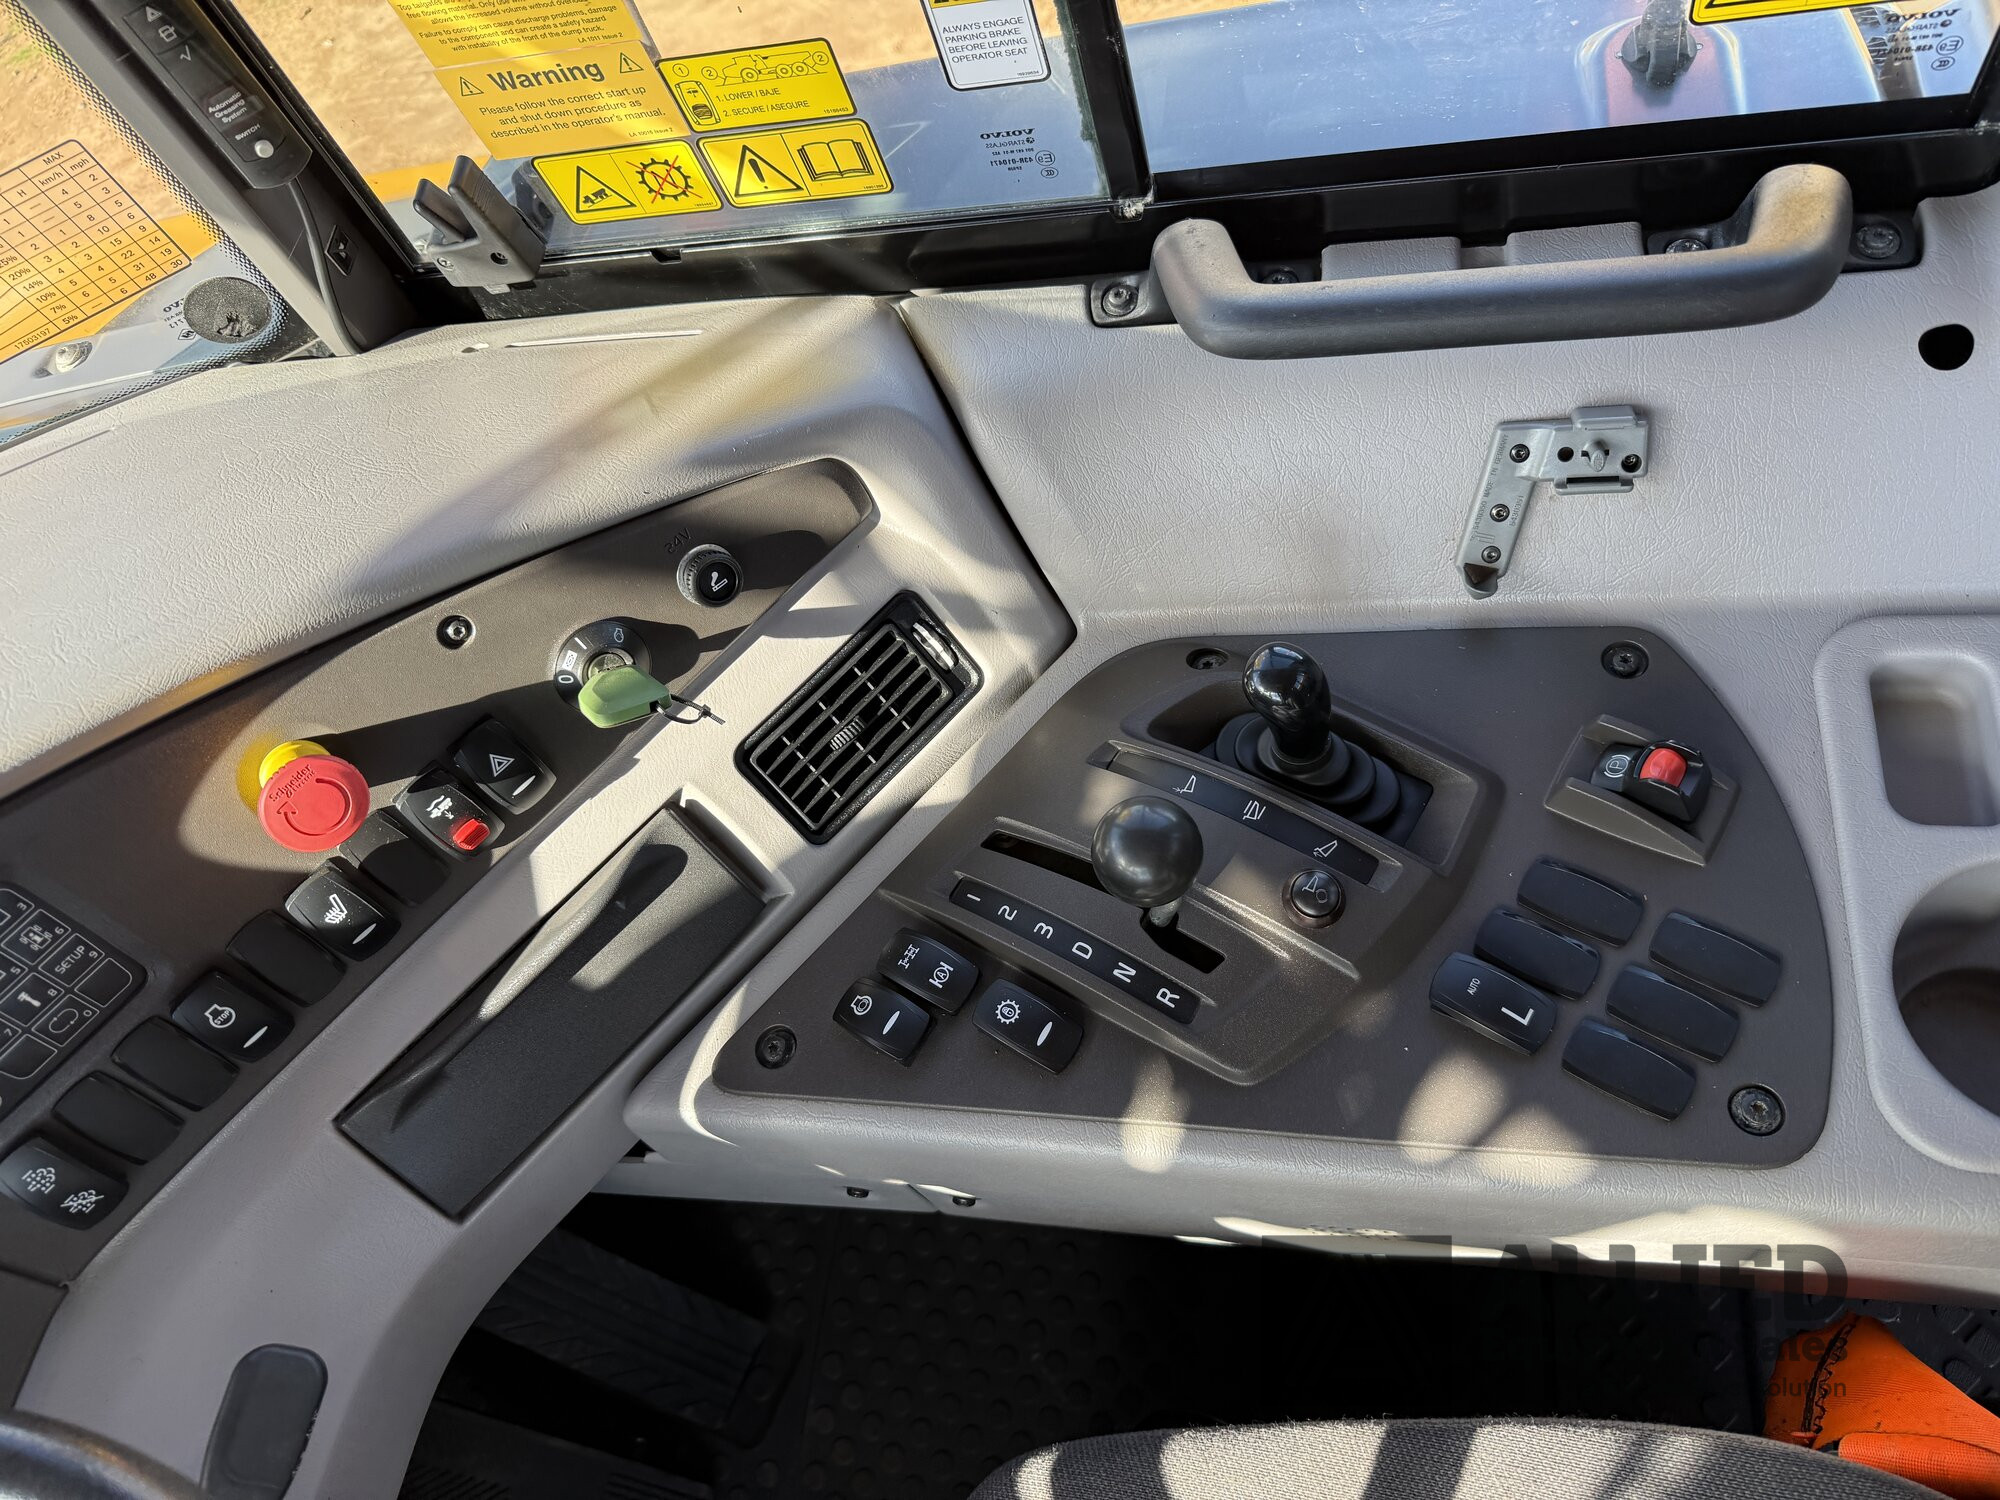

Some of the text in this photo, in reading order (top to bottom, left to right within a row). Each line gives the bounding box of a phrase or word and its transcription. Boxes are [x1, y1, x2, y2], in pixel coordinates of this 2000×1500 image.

[465, 8, 500, 19] increased
[529, 0, 556, 10] without
[452, 24, 478, 33] comply
[513, 15, 550, 24] discharge
[550, 10, 587, 20] problems,
[586, 5, 616, 13] damage
[941, 16, 1024, 33] ALWAYS ENGAGE
[460, 30, 499, 41] component
[529, 23, 552, 31] create
[558, 18, 581, 26] safety
[580, 14, 606, 23] hazard
[944, 27, 1020, 43] PARKING BRAKE
[466, 39, 501, 49] instability
[581, 24, 604, 32] truck.
[948, 36, 1027, 53] BEFORE LEAVING
[950, 46, 1028, 63] OPERATOR SEAT
[487, 64, 606, 93] Warning
[479, 105, 513, 115] Please
[514, 100, 545, 110] follow
[546, 96, 565, 105] the
[566, 90, 603, 102] correct
[605, 86, 630, 97] start
[723, 90, 753, 100] LOWER
[758, 86, 779, 95] BAJE
[208, 92, 242, 113] Automatic
[214, 99, 245, 118] Greasing
[731, 105, 765, 115] SECURE
[769, 99, 809, 110] ASEGURE
[222, 107, 247, 123] System
[499, 115, 518, 125] and
[519, 112, 542, 122] shut
[543, 109, 572, 118] down
[574, 102, 626, 116] procedure
[490, 124, 539, 138] described
[551, 121, 569, 129] the
[571, 113, 622, 128] operator's
[624, 107, 665, 119] manual.
[235, 124, 261, 140] SWITCH
[43, 152, 64, 166] MAX
[39, 158, 90, 186] km/h mph
[89, 173, 98, 182] 2
[17, 189, 27, 197] H
[61, 188, 69, 196] 4
[102, 186, 111, 195] 3
[74, 201, 82, 209] 5
[87, 214, 95, 222] 8
[97, 225, 110, 235] 10
[110, 238, 122, 248] 15
[149, 236, 161, 245] 14
[121, 250, 135, 260] 22
[160, 247, 172, 257] 19
[133, 262, 145, 272] 31
[170, 259, 183, 269] 30
[9, 268, 31, 280] 20%
[145, 272, 157, 282] 48
[23, 280, 43, 291] 14%
[36, 291, 56, 303] 10%
[50, 303, 67, 314] 7%
[62, 314, 78, 325] 5%
[14, 328, 52, 351] 17503197
[1483, 434, 1509, 497] MADE IN GERMANY
[664, 528, 692, 554] 24V
[269, 764, 311, 802] Schneider
[17, 902, 27, 911] 3
[997, 905, 1018, 921] 2
[55, 927, 64, 935] 6
[1033, 922, 1054, 940] 3
[1071, 941, 1093, 960] D
[55, 944, 86, 975] SETUP
[10, 967, 21, 975] 5
[1112, 962, 1136, 983] N
[48, 988, 58, 997] 8
[1467, 978, 1480, 995] AUTO
[1155, 987, 1180, 1008] R
[214, 1010, 230, 1025] STOP
[4, 1028, 14, 1037] 7
